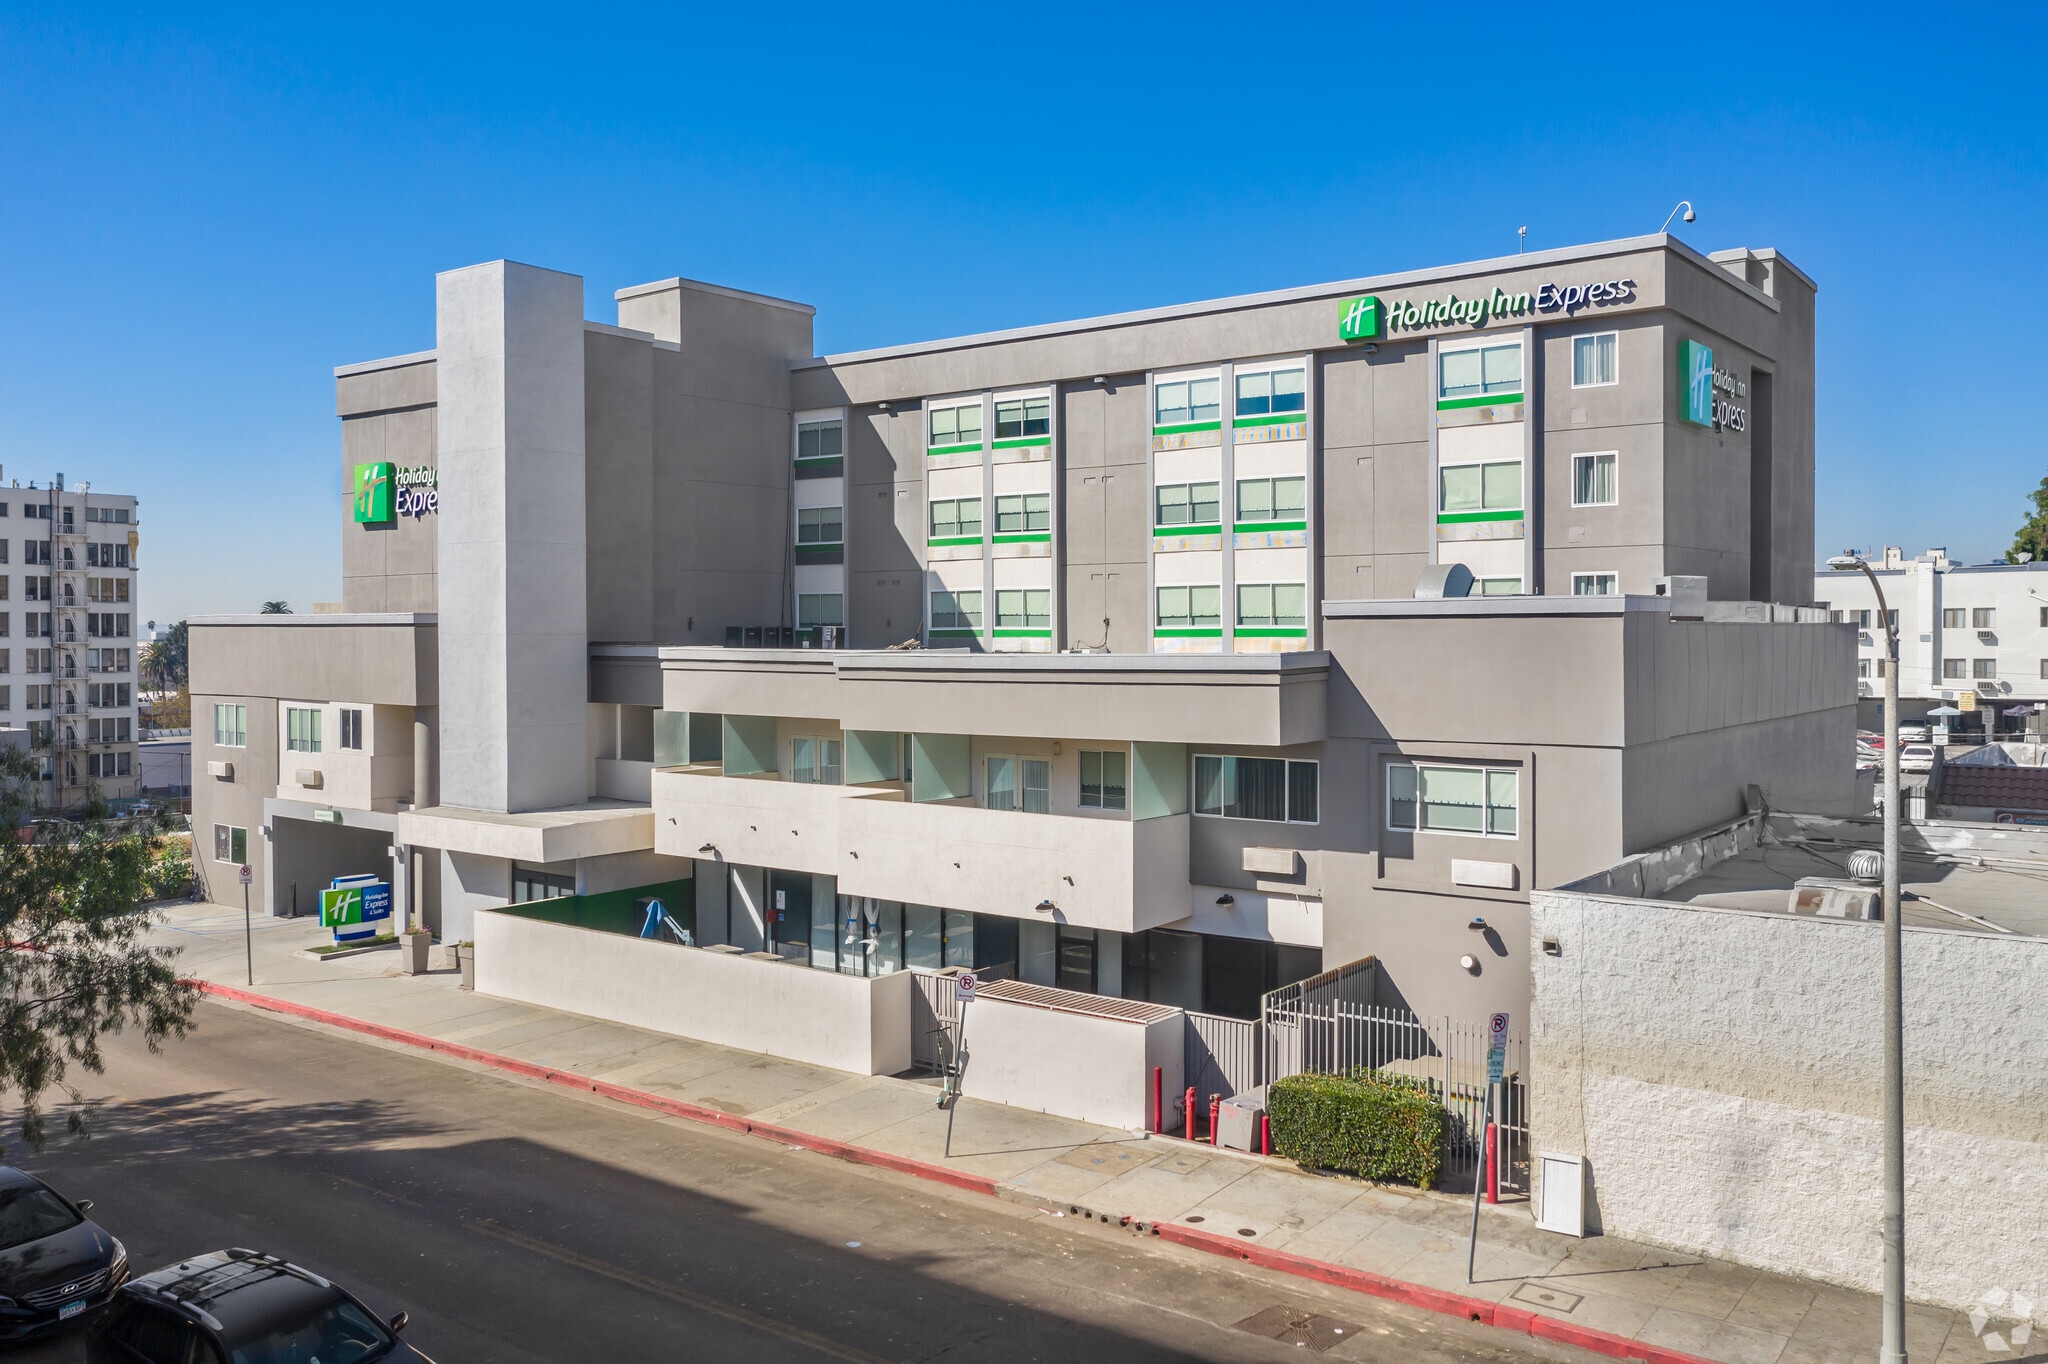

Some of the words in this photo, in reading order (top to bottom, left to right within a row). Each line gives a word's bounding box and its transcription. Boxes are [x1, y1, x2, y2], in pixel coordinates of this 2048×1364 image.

[1385, 294, 1486, 328] Holiday
[1488, 287, 1531, 314] Inn
[1535, 278, 1632, 312] Express
[395, 466, 435, 486] Holiday
[395, 487, 438, 518] Expre
[365, 898, 388, 909] Express
